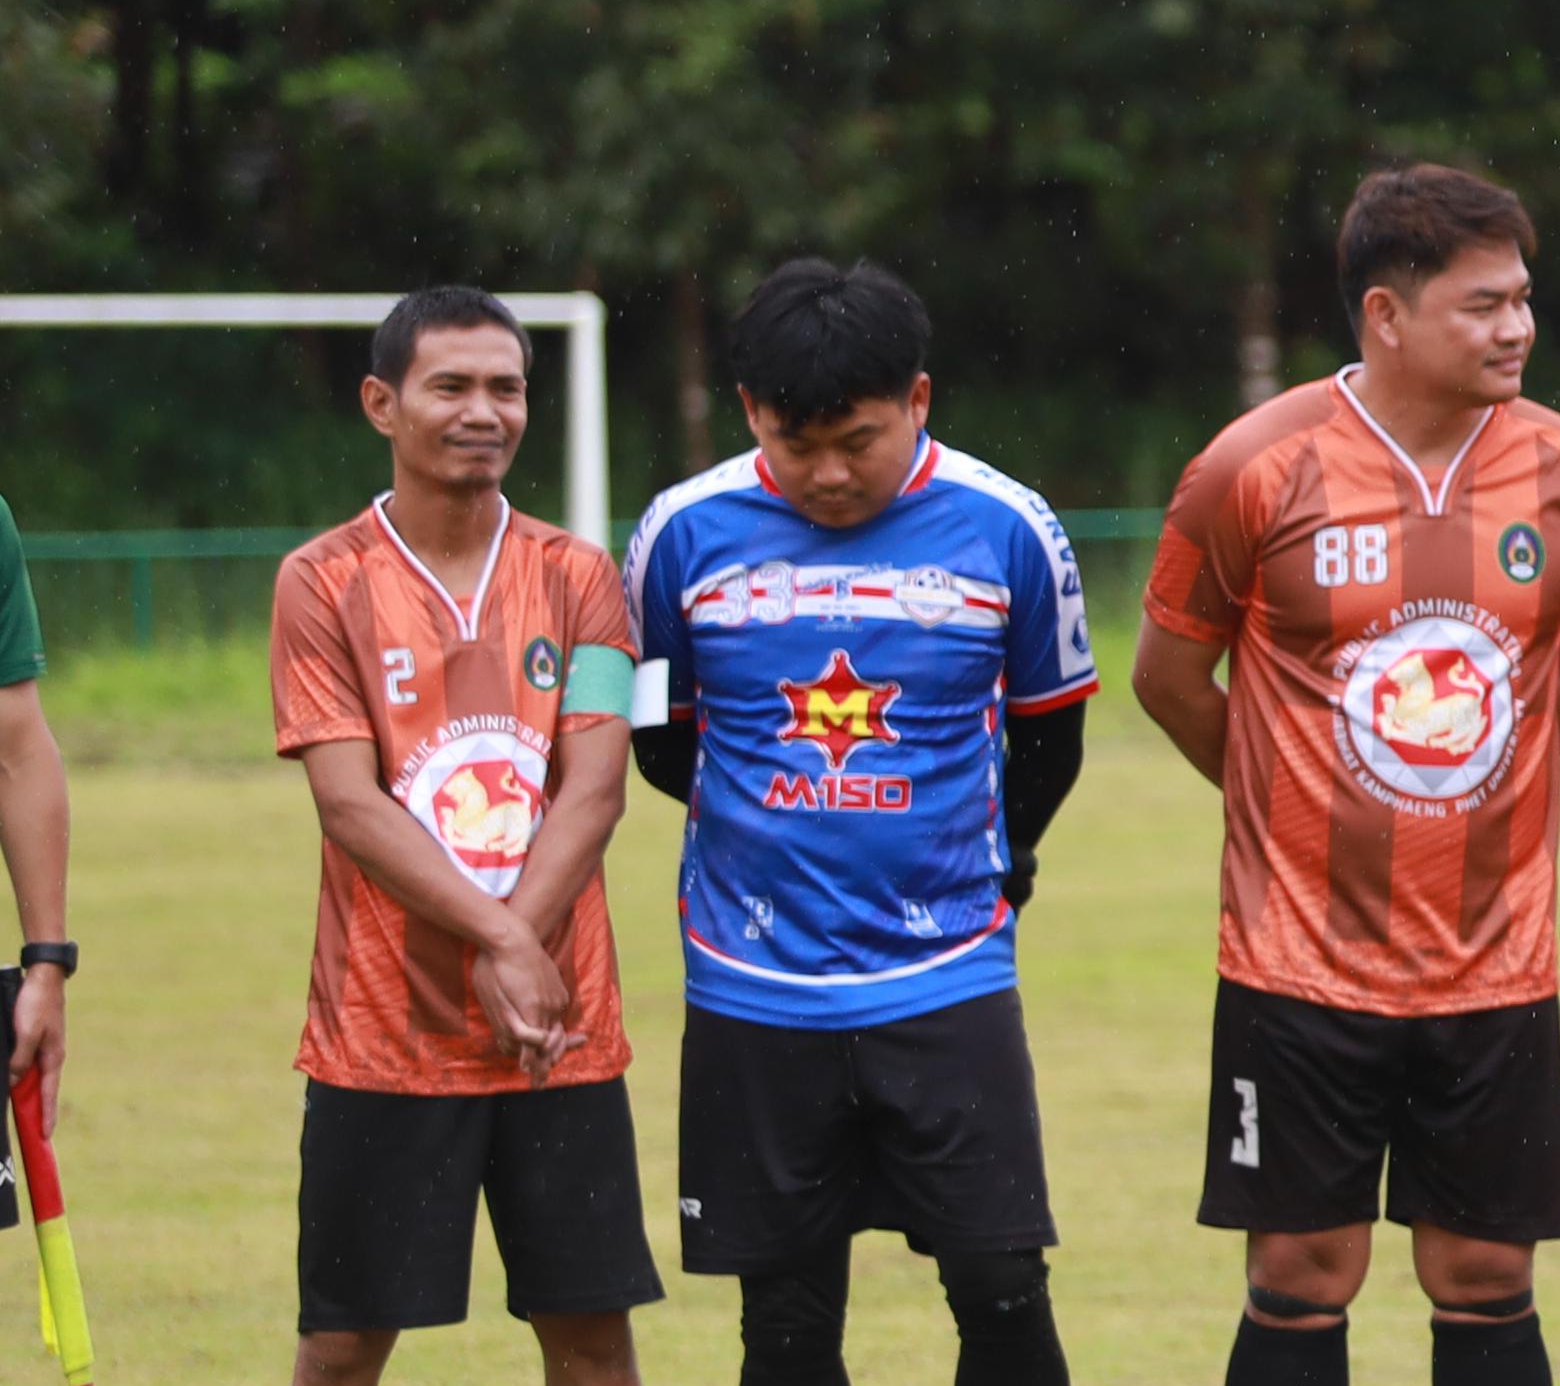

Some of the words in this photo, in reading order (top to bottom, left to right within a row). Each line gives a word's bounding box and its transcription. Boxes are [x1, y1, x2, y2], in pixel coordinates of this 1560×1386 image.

[1313, 523, 1389, 588] 88
[690, 559, 797, 630] 33
[383, 646, 418, 706] 2
[801, 688, 874, 738] M
[391, 739, 437, 797] PUBLIC
[763, 771, 913, 813] M-150
[1356, 769, 1446, 818] KAMPHAENG
[1454, 789, 1489, 814] PHET
